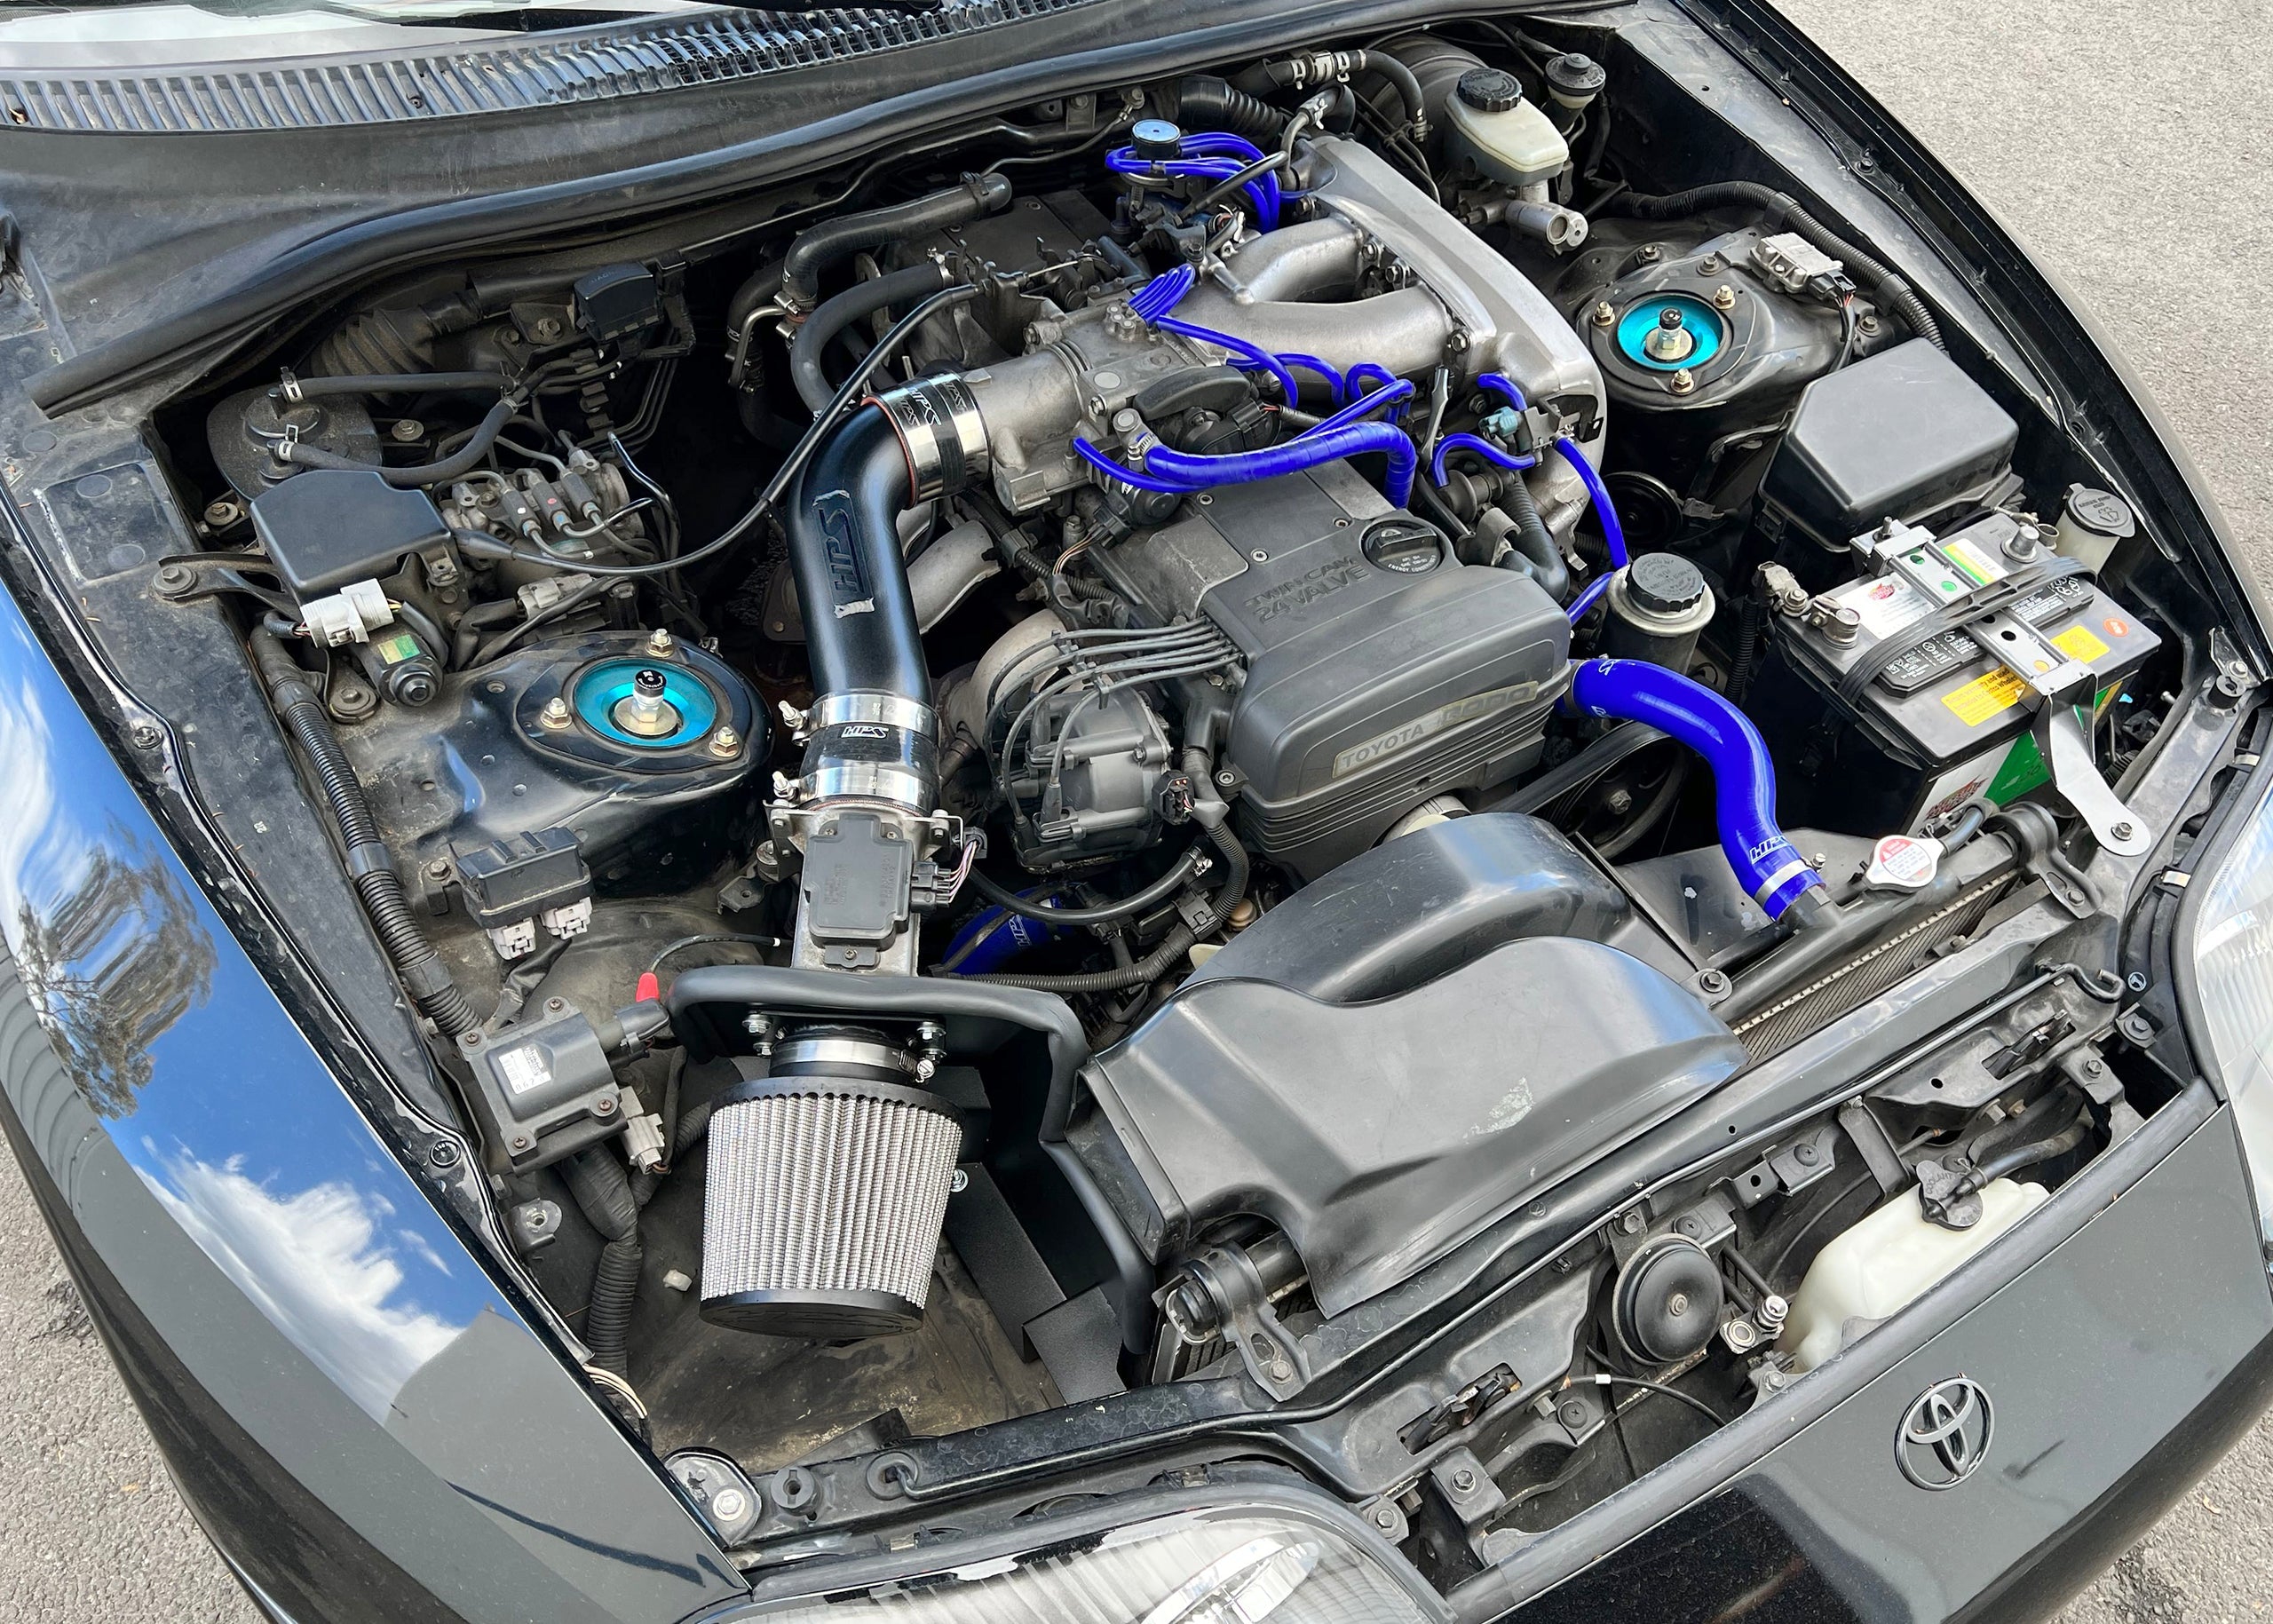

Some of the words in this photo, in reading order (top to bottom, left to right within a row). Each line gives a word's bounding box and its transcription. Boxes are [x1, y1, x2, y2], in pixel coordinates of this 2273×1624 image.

[818, 507, 865, 593] HPS
[1245, 577, 1305, 606] TWIN
[1304, 556, 1355, 582] CAM
[1253, 598, 1292, 623] 24
[1289, 565, 1372, 605] VALVE
[841, 725, 890, 739] HPS
[1342, 724, 1424, 768] TOYOTA
